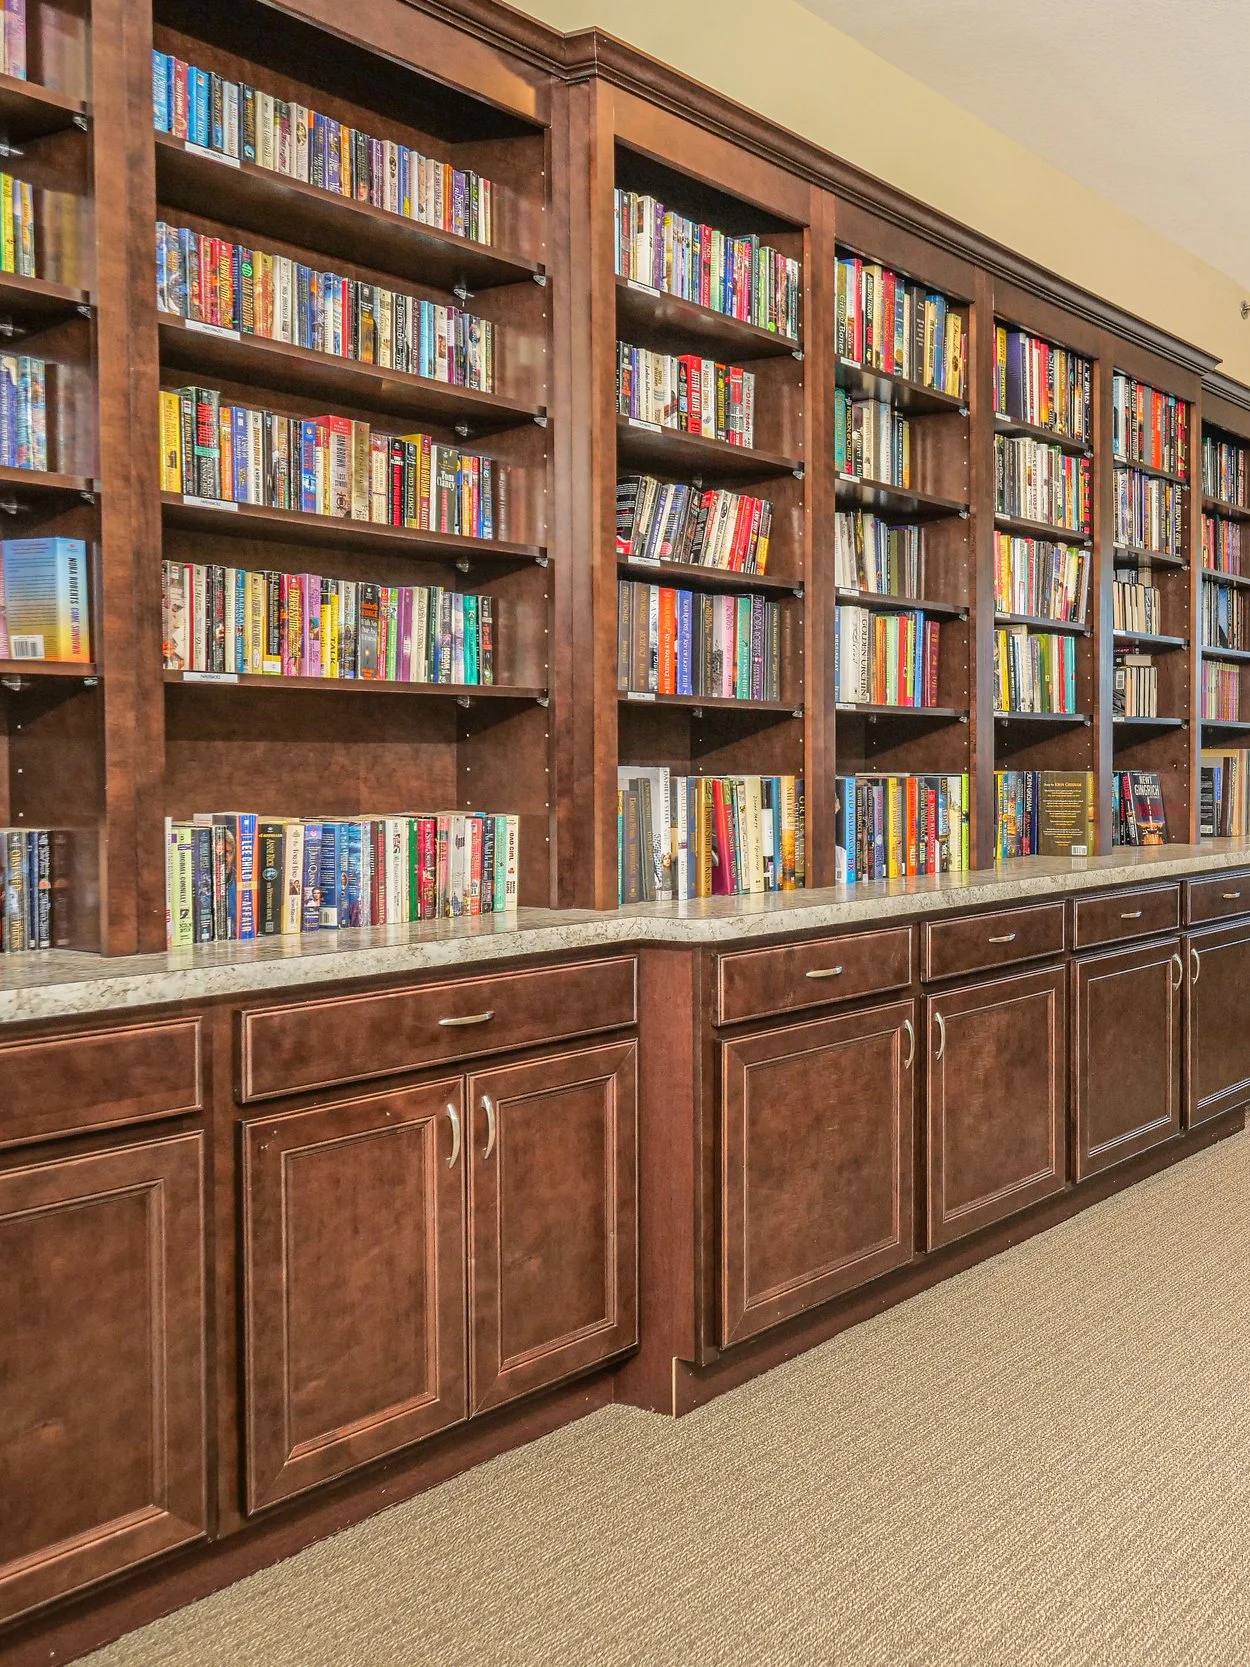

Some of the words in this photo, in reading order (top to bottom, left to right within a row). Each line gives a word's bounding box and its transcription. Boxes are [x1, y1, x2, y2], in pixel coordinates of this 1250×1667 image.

[242, 276, 252, 295] DAN
[242, 295, 252, 327] BROWN
[691, 368, 699, 391] JEFFERY
[691, 391, 699, 412] DEAVER
[336, 434, 345, 447] DAN
[336, 447, 346, 468] BROWN
[421, 452, 429, 469] JOHN
[421, 469, 429, 497] GRISHAM
[68, 557, 77, 573] NORA
[69, 577, 78, 604] ROBERTS
[752, 631, 760, 655] ROBERTS
[1134, 783, 1160, 796] GINGRICH
[1138, 775, 1152, 784] NEWT
[241, 840, 251, 855] LEE
[241, 856, 252, 879] CHILD
[242, 901, 252, 932] AFFAIR
